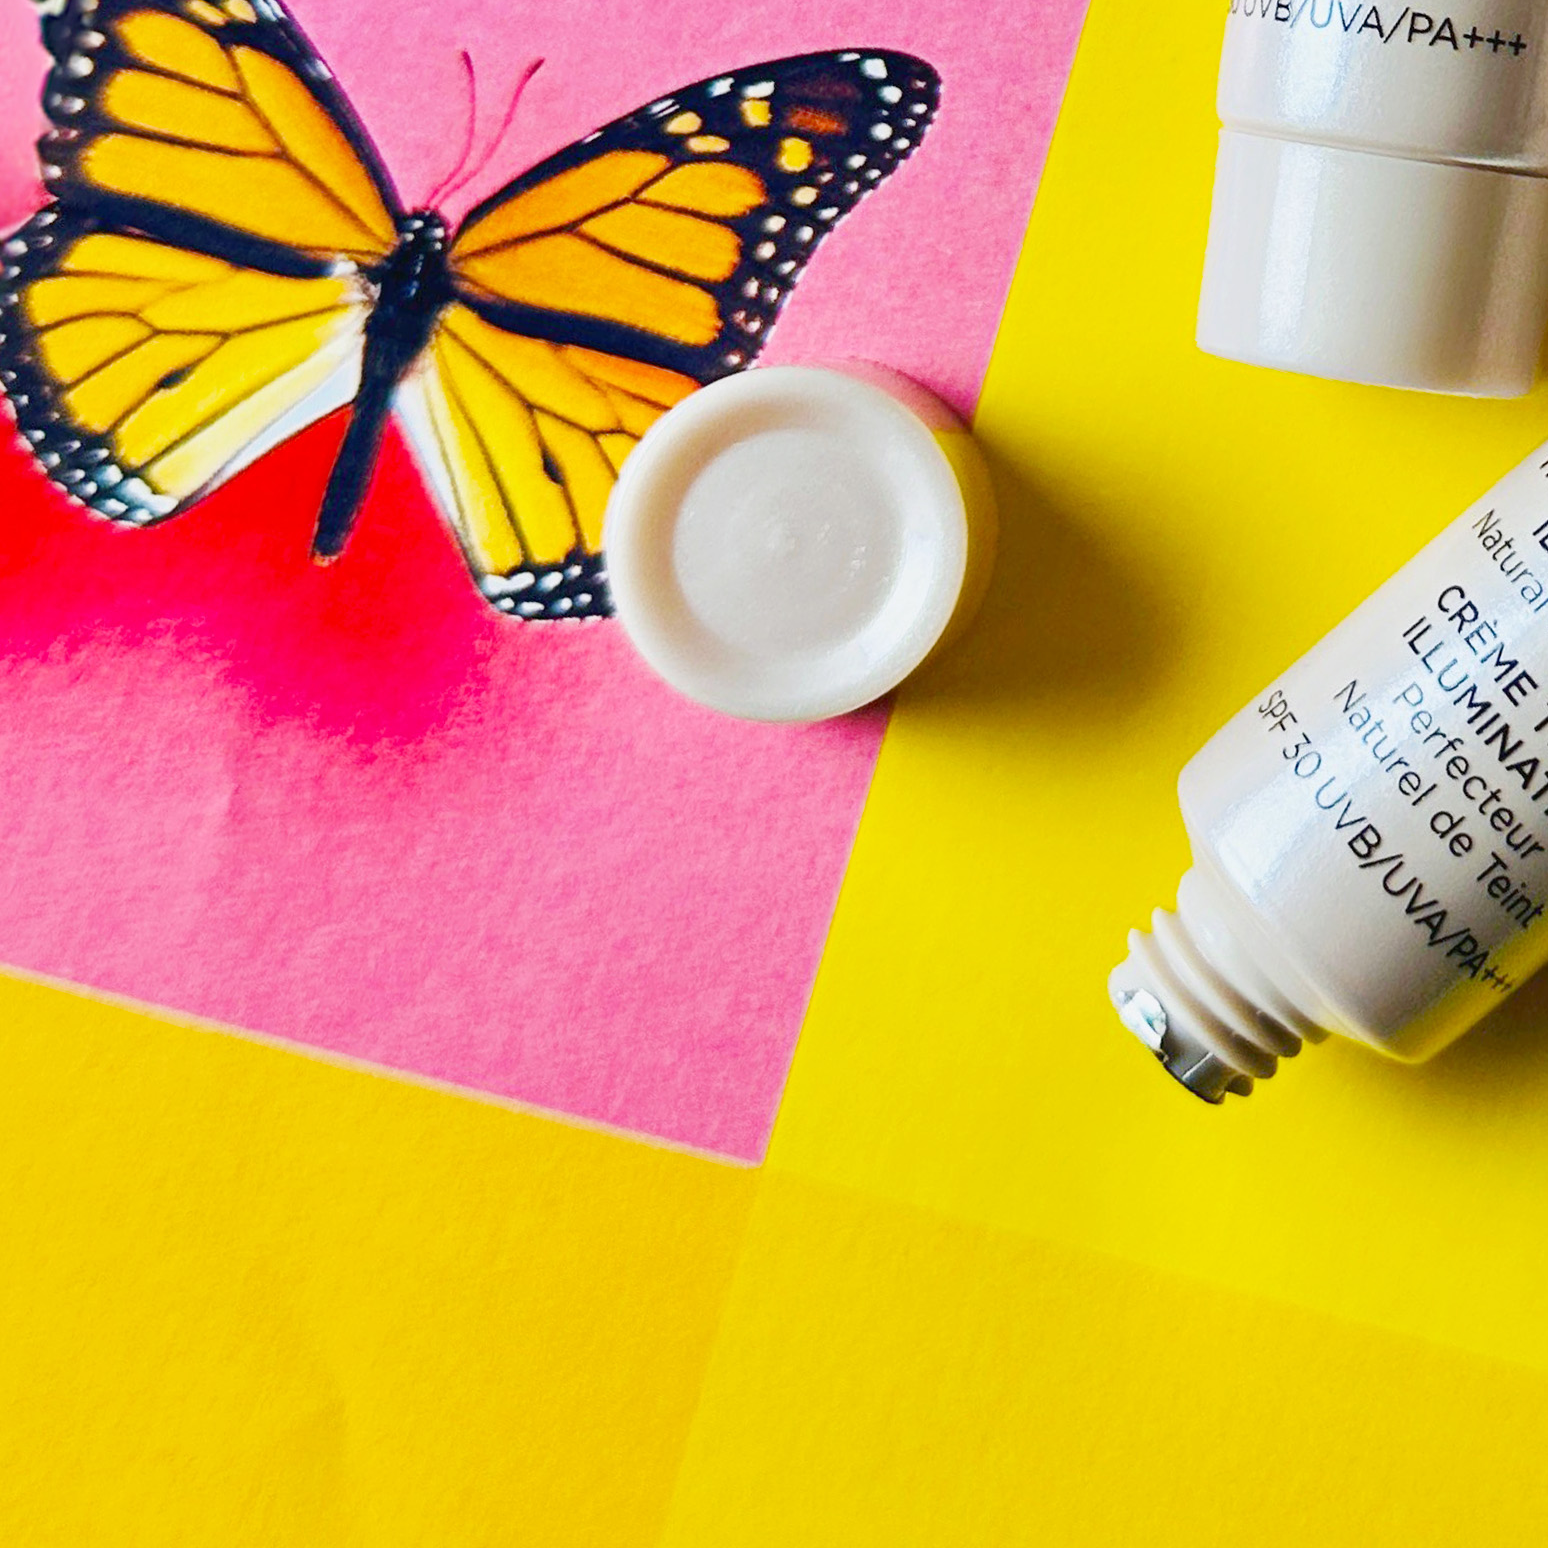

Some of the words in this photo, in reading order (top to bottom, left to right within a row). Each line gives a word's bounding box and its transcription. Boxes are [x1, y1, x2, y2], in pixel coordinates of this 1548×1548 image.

[1437, 584, 1539, 708] CRÈME
[1258, 688, 1298, 733] SPF
[1282, 731, 1323, 779] 30
[1332, 678, 1438, 807] Naturel
[1430, 810, 1474, 858] de
[1476, 850, 1545, 930] Teint
[1393, 681, 1546, 860] Perfecteur
